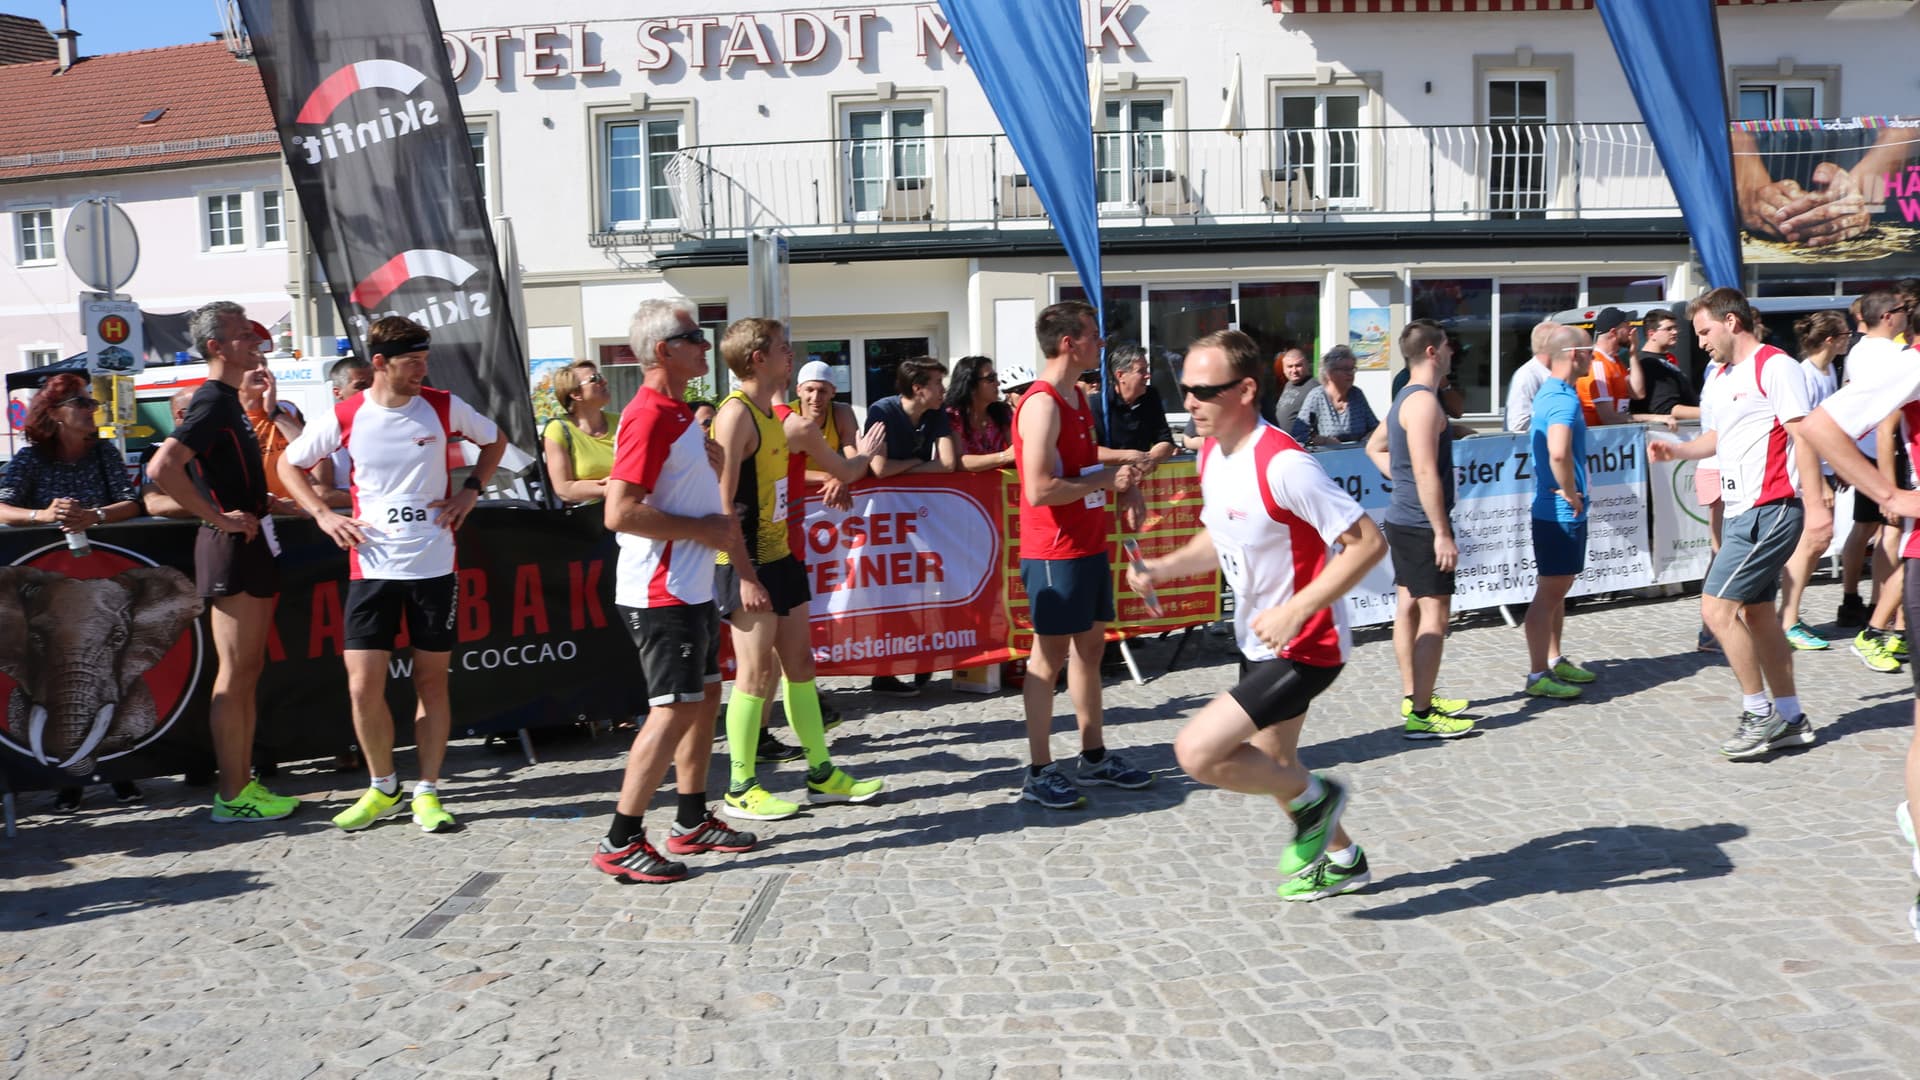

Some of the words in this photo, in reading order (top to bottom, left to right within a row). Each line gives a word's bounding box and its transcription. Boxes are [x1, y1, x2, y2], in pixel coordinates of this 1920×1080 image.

[441, 24, 606, 81] OTEL
[637, 8, 877, 72] STADT
[106, 321, 123, 338] H
[1514, 452, 1532, 480] Z
[1585, 443, 1636, 475] mbH
[387, 506, 428, 524] 26a
[808, 511, 918, 555] OSEF
[1672, 537, 1713, 550] Vinothe
[806, 551, 945, 595] EINER
[1455, 562, 1510, 579] eselburg
[1588, 547, 1624, 562] Straße
[1627, 545, 1638, 558] 13
[1477, 580, 1501, 593] Fax
[1503, 575, 1524, 590] DW
[1576, 561, 1644, 582] e@schug.at
[461, 639, 578, 672] COCCAO
[811, 629, 977, 663] sefsteiner.com
